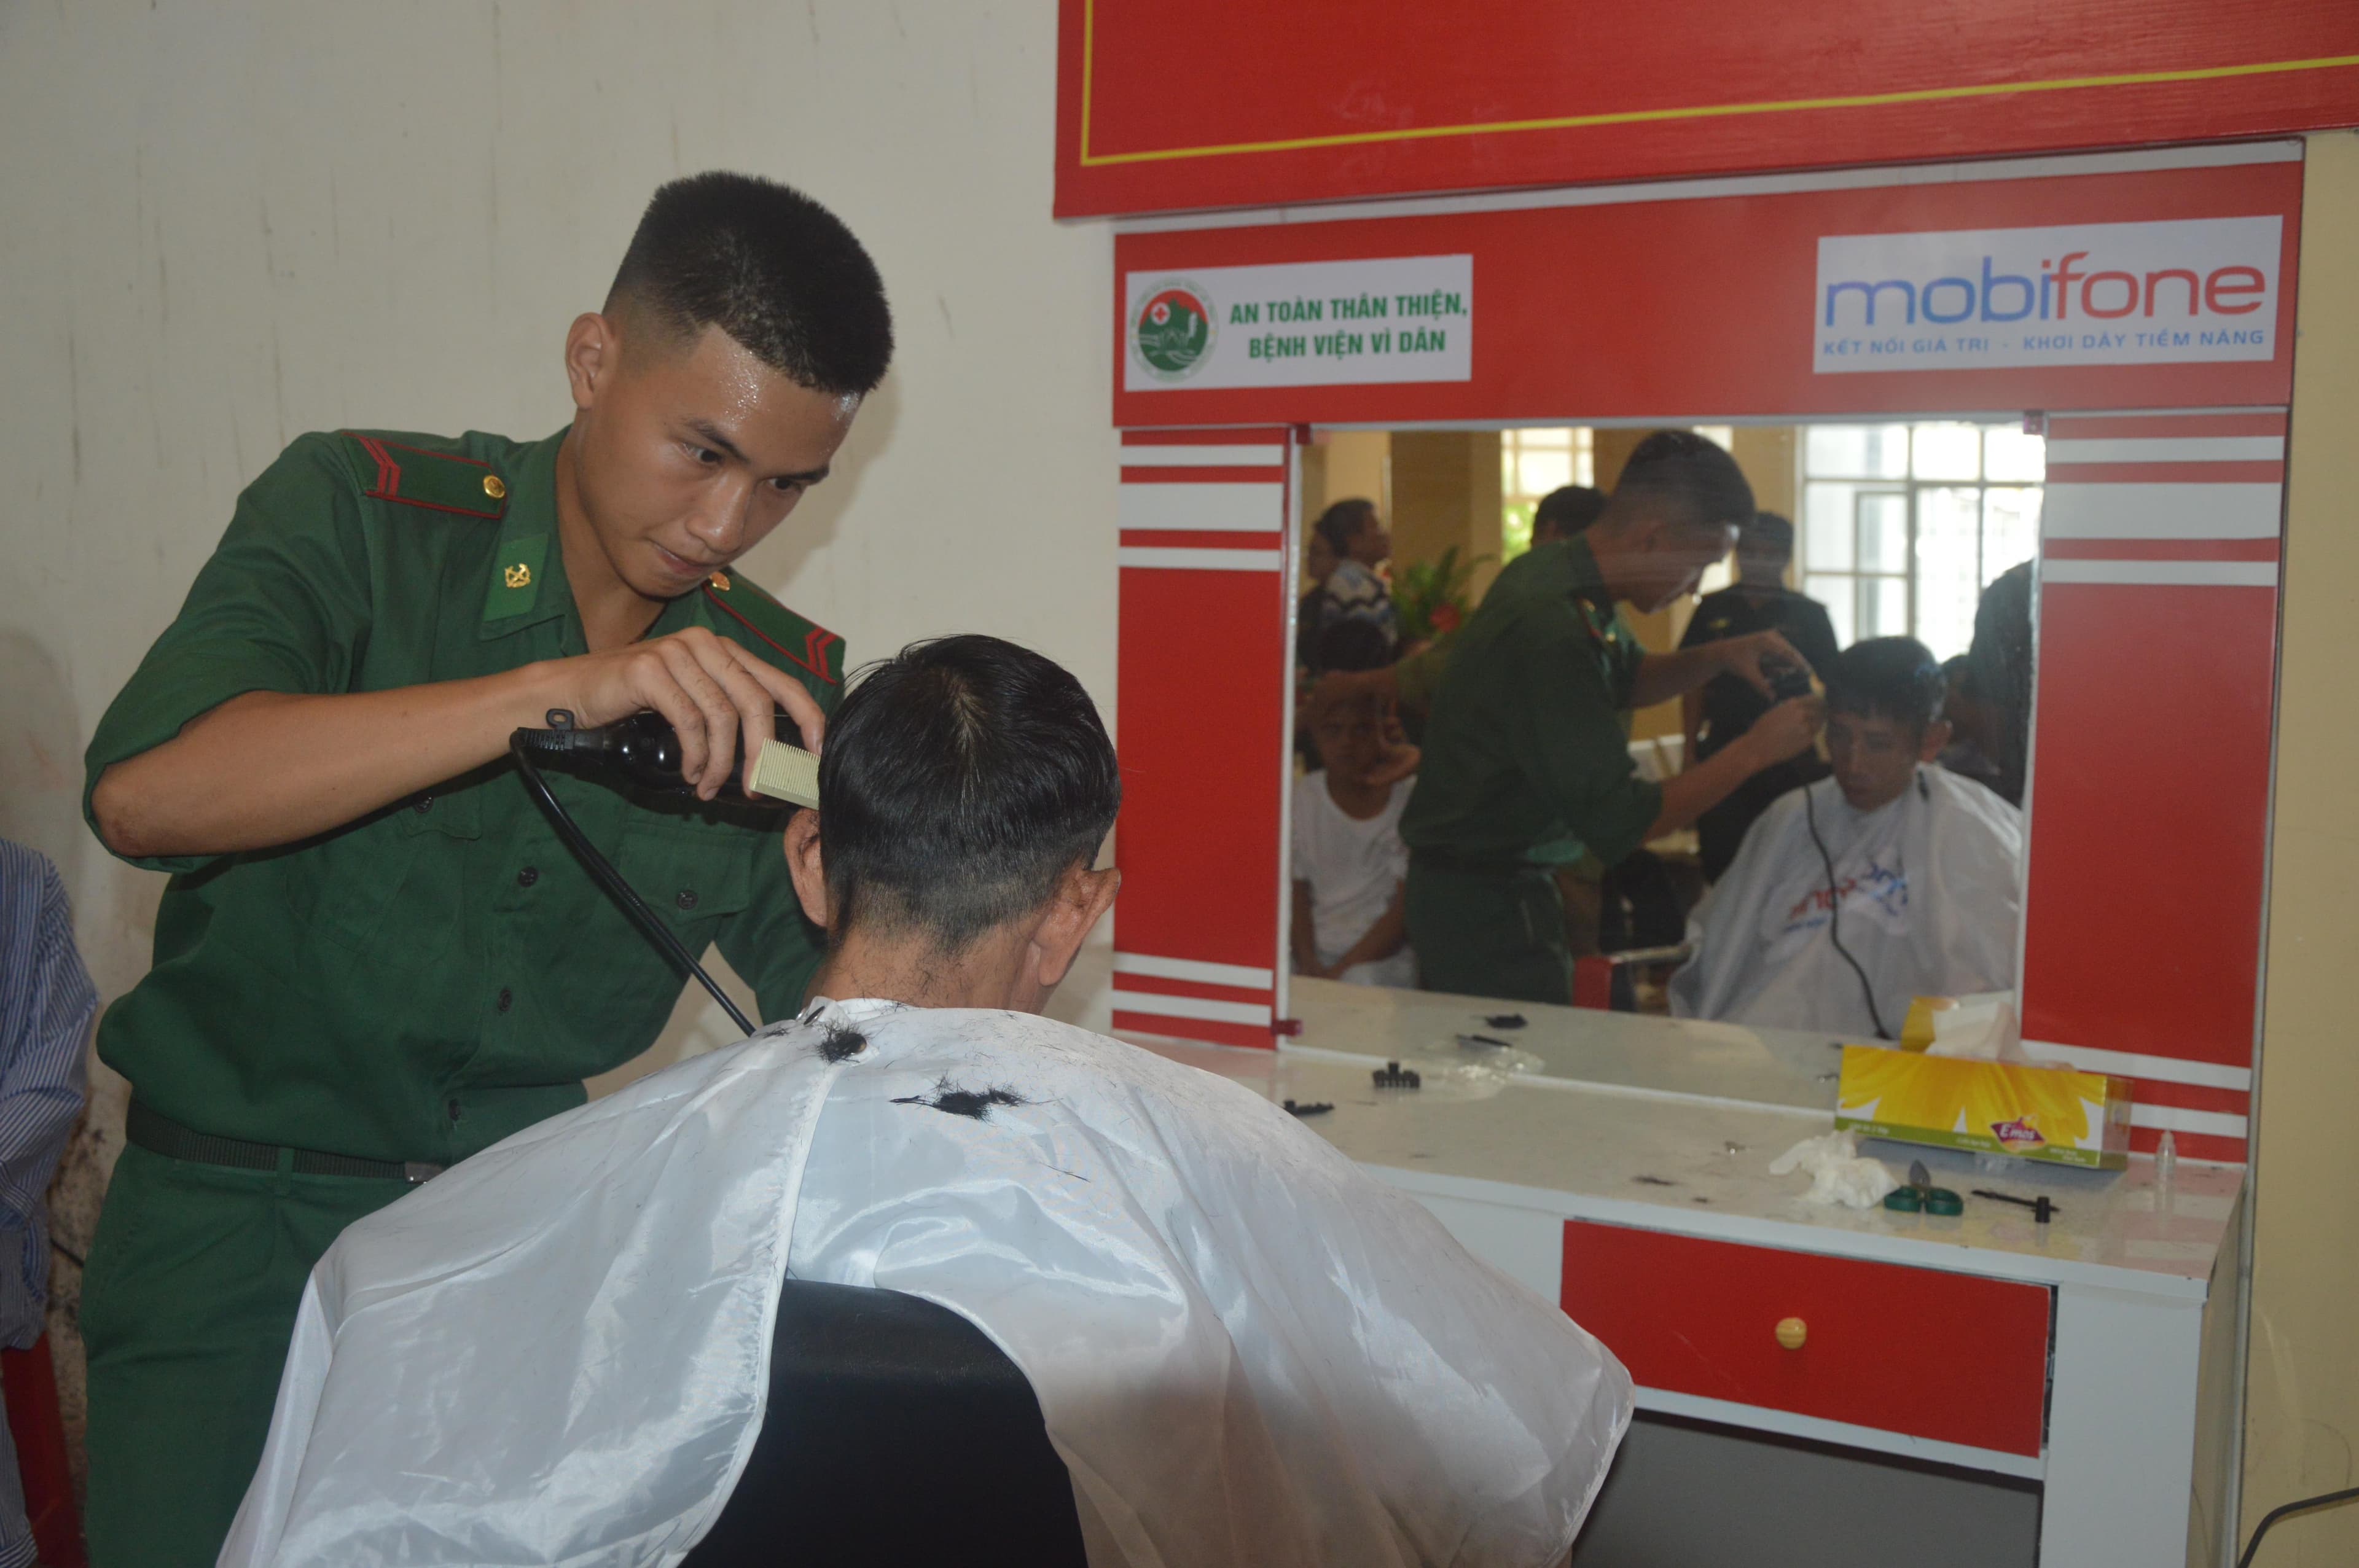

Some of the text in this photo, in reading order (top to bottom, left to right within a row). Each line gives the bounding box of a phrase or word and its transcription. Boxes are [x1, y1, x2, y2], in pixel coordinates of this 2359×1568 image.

[1825, 251, 2266, 327] mobifone
[1229, 304, 1259, 324] AN
[1267, 296, 1323, 322] TOÀN
[1329, 292, 1388, 320] THÂN
[1249, 326, 1446, 363] BỆNH VIỆN VÌ DÂN
